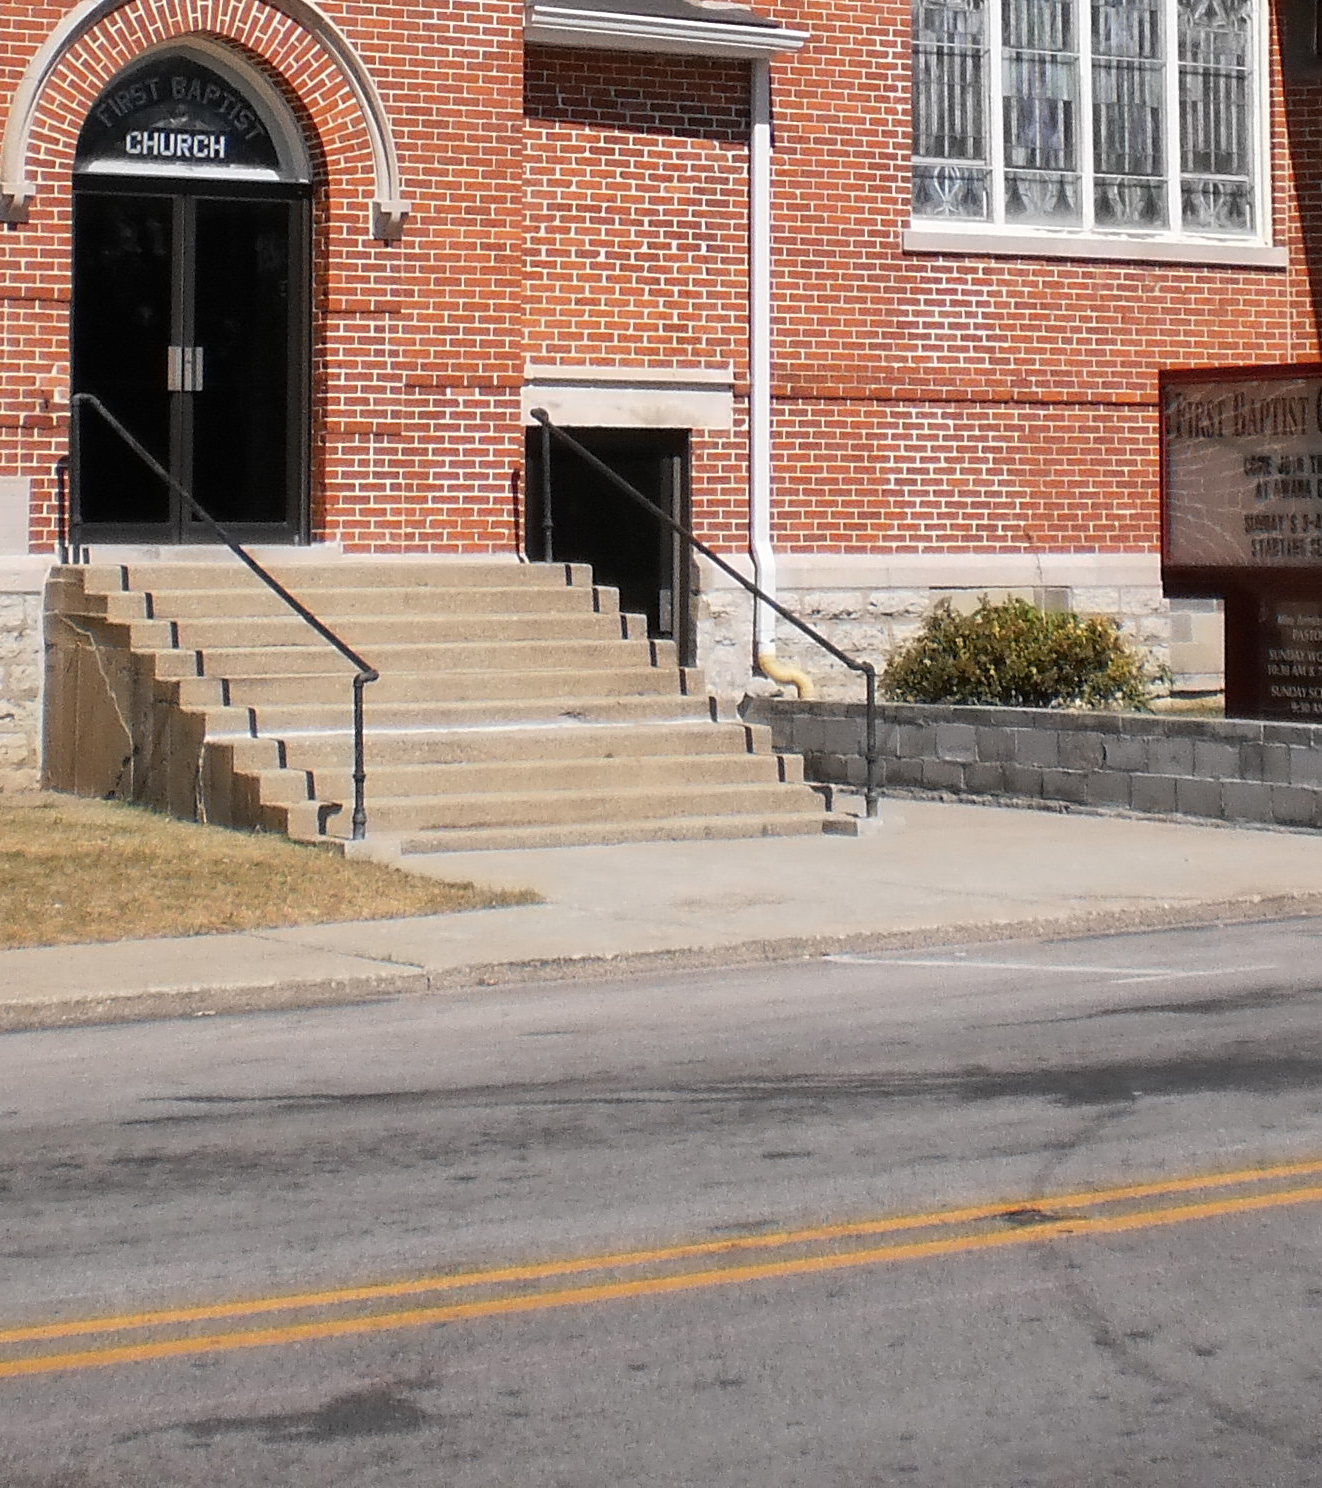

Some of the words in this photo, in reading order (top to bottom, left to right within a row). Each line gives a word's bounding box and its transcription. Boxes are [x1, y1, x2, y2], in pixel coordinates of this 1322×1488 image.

[96, 77, 160, 128] FIRST
[171, 76, 265, 141] BAPTIST
[125, 131, 226, 159] CHURCH
[1233, 391, 1309, 437] BAPTIST
[1255, 478, 1269, 499] AT
[1269, 649, 1305, 662] SUNDAY
[1292, 664, 1306, 677] AM
[1271, 685, 1306, 698] SUNDAY
